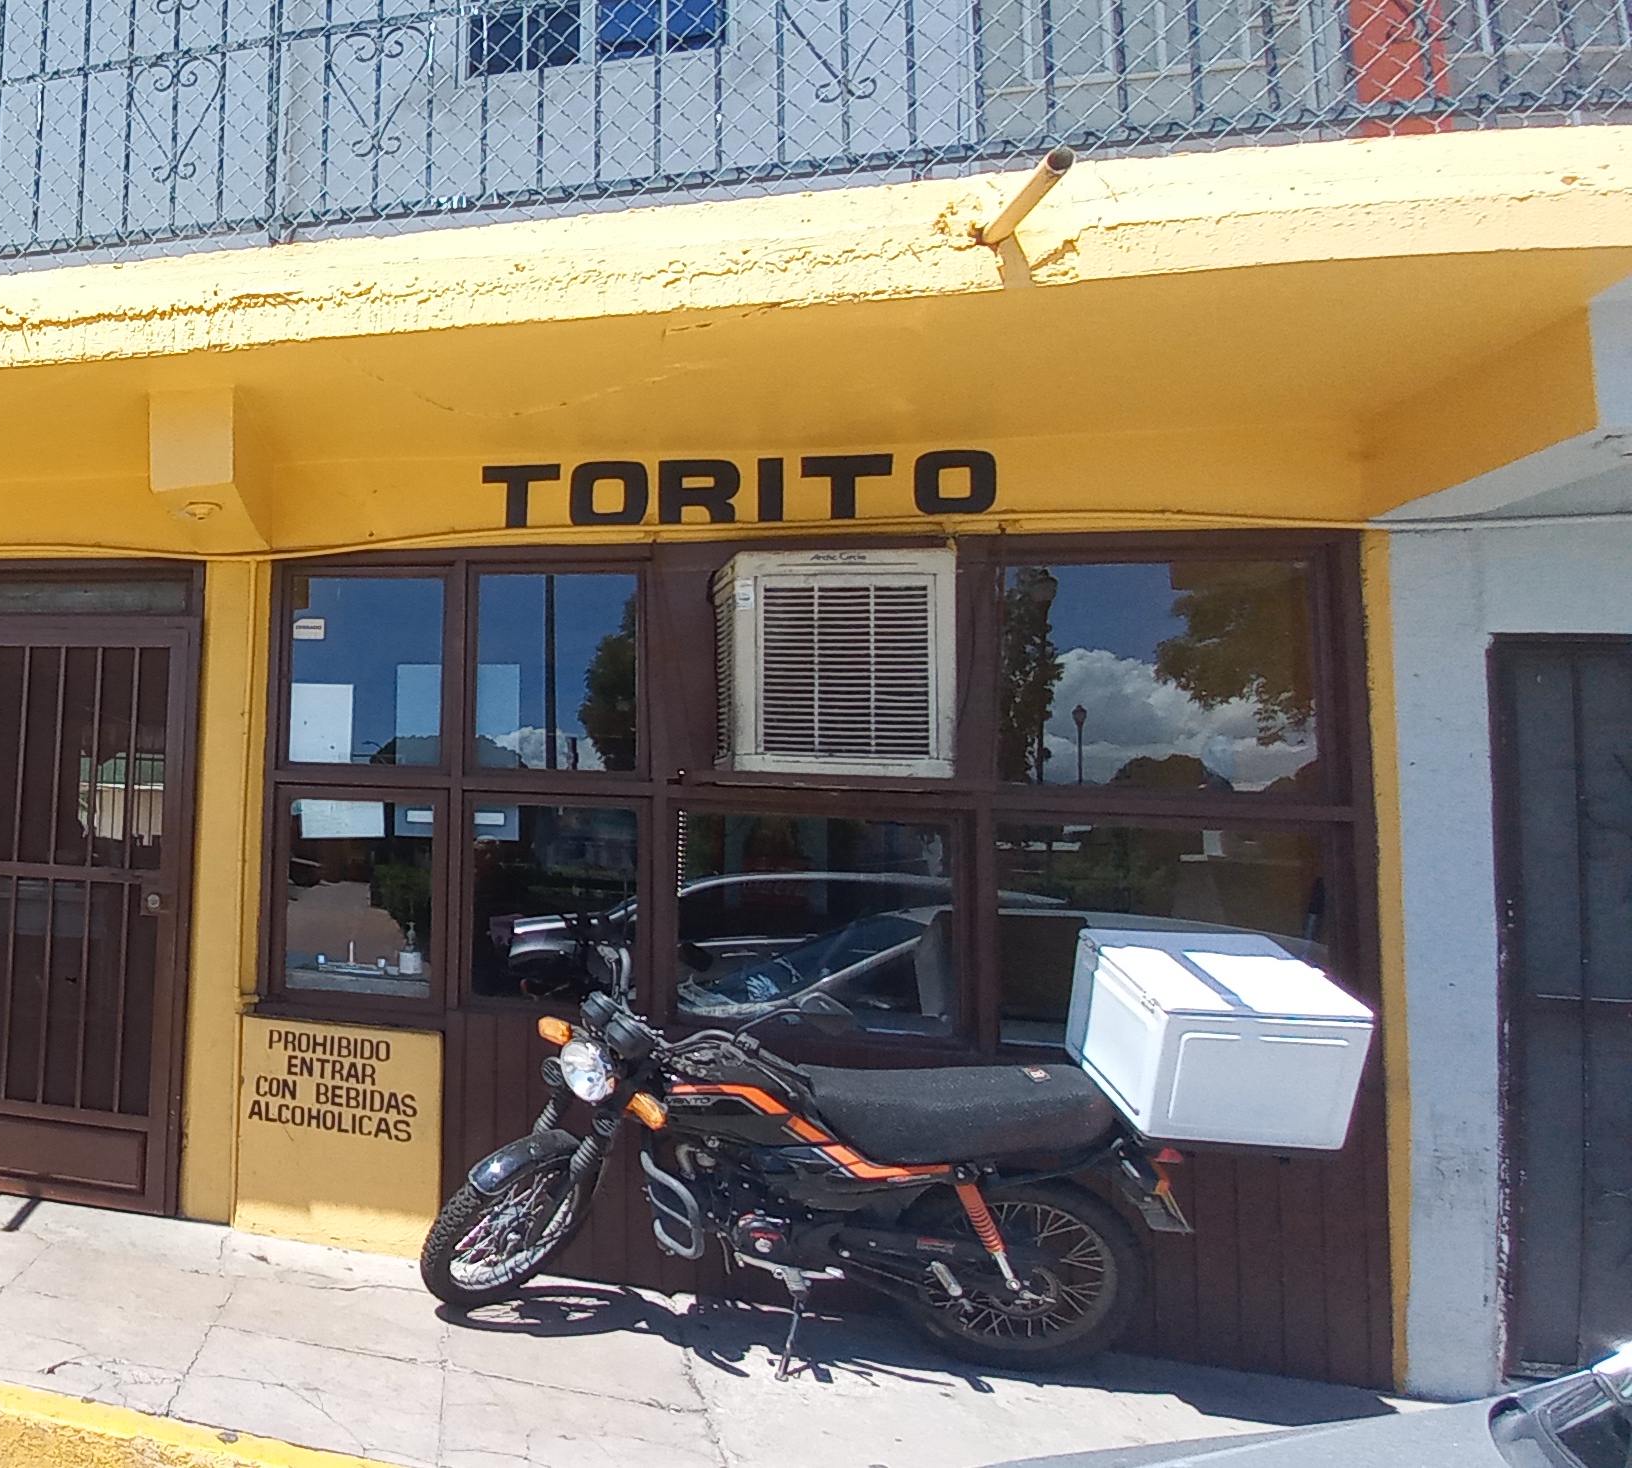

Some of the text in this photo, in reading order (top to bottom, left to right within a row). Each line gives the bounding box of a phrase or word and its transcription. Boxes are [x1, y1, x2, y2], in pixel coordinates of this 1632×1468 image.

[482, 449, 997, 528] TORITO
[268, 1029, 391, 1062] PROHIBIDO
[287, 1055, 376, 1086] ENTRAR
[255, 1075, 417, 1118] CON BEBIDAS
[248, 1100, 412, 1143] ALCOHOLICAS
